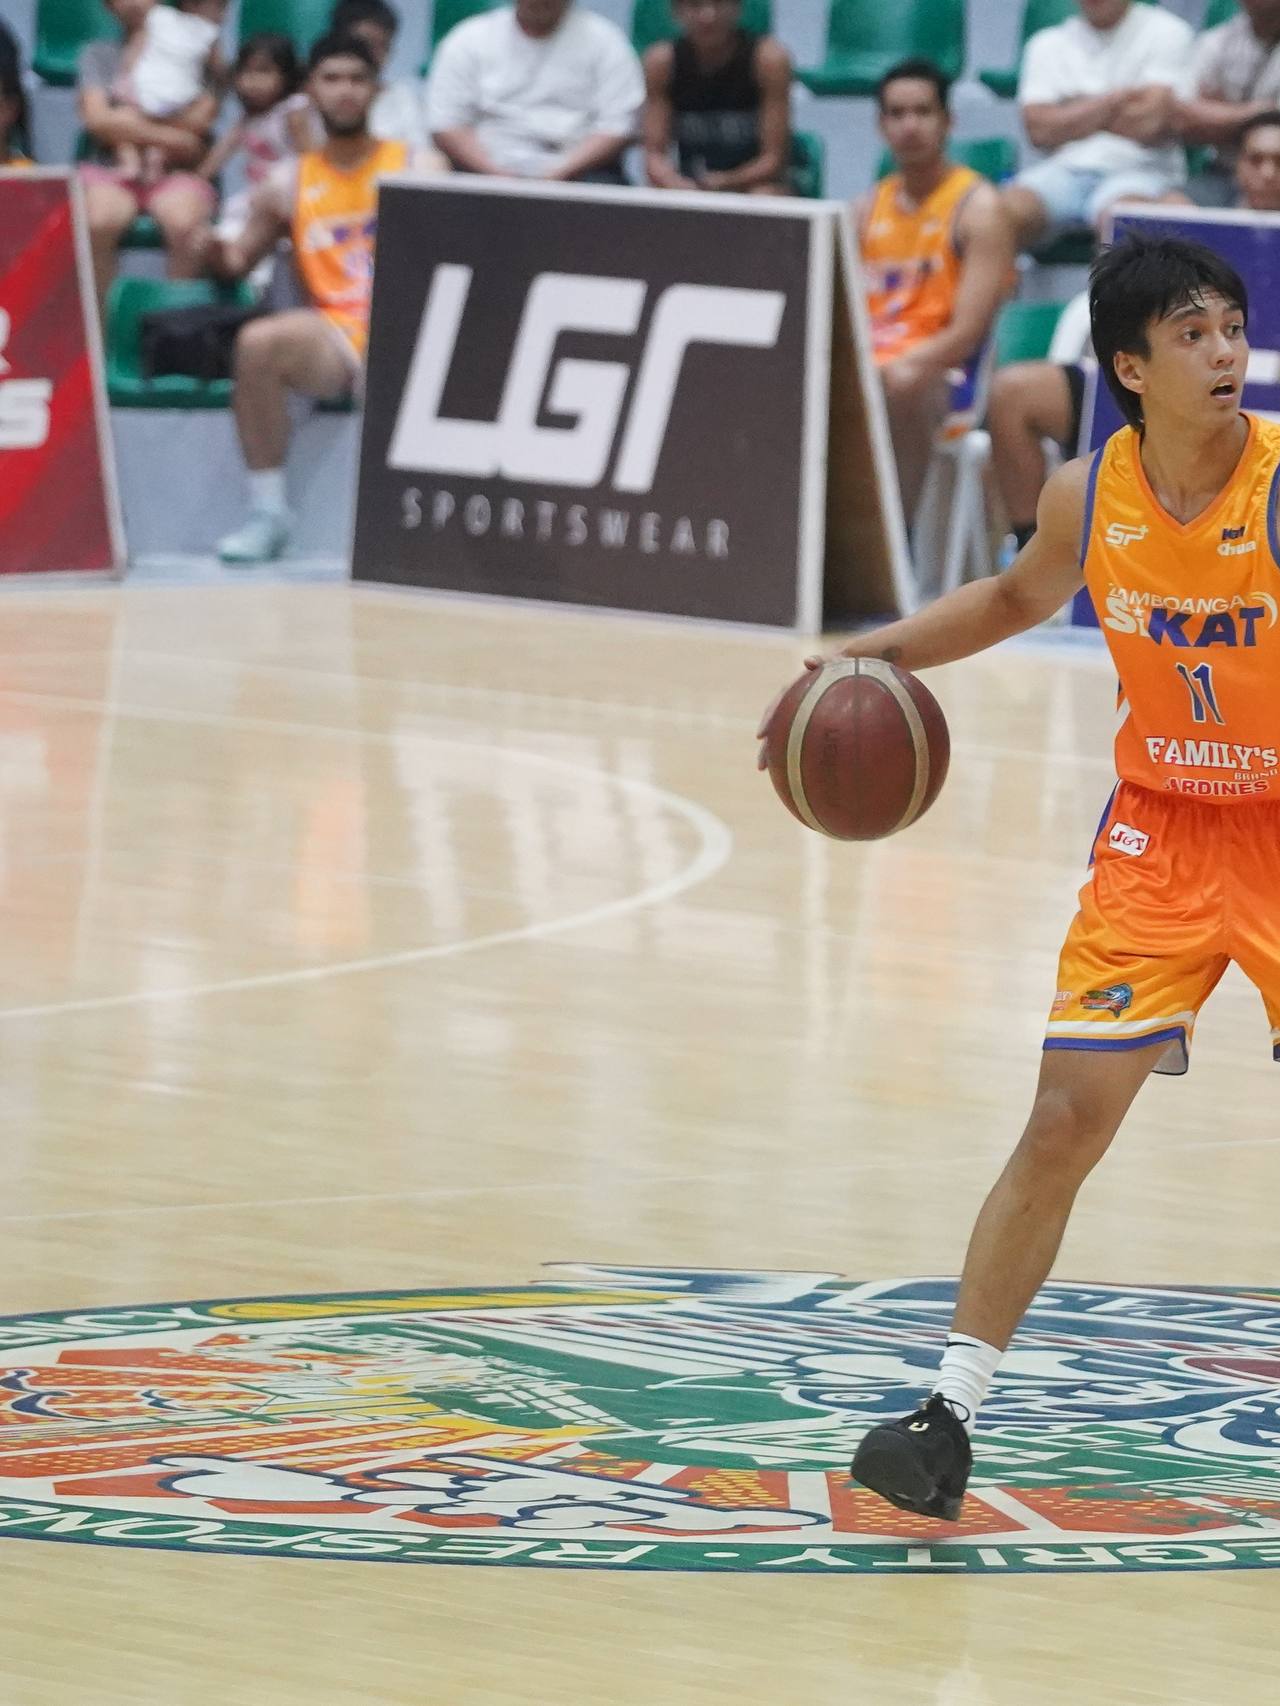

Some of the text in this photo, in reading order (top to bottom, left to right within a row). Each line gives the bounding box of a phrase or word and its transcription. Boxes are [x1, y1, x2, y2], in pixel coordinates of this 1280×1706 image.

[401, 487, 731, 560] SPORTSWEAR
[1175, 662, 1226, 726] 11
[1145, 735, 1280, 771] FAMILY'S
[1165, 777, 1269, 796] ARDINES
